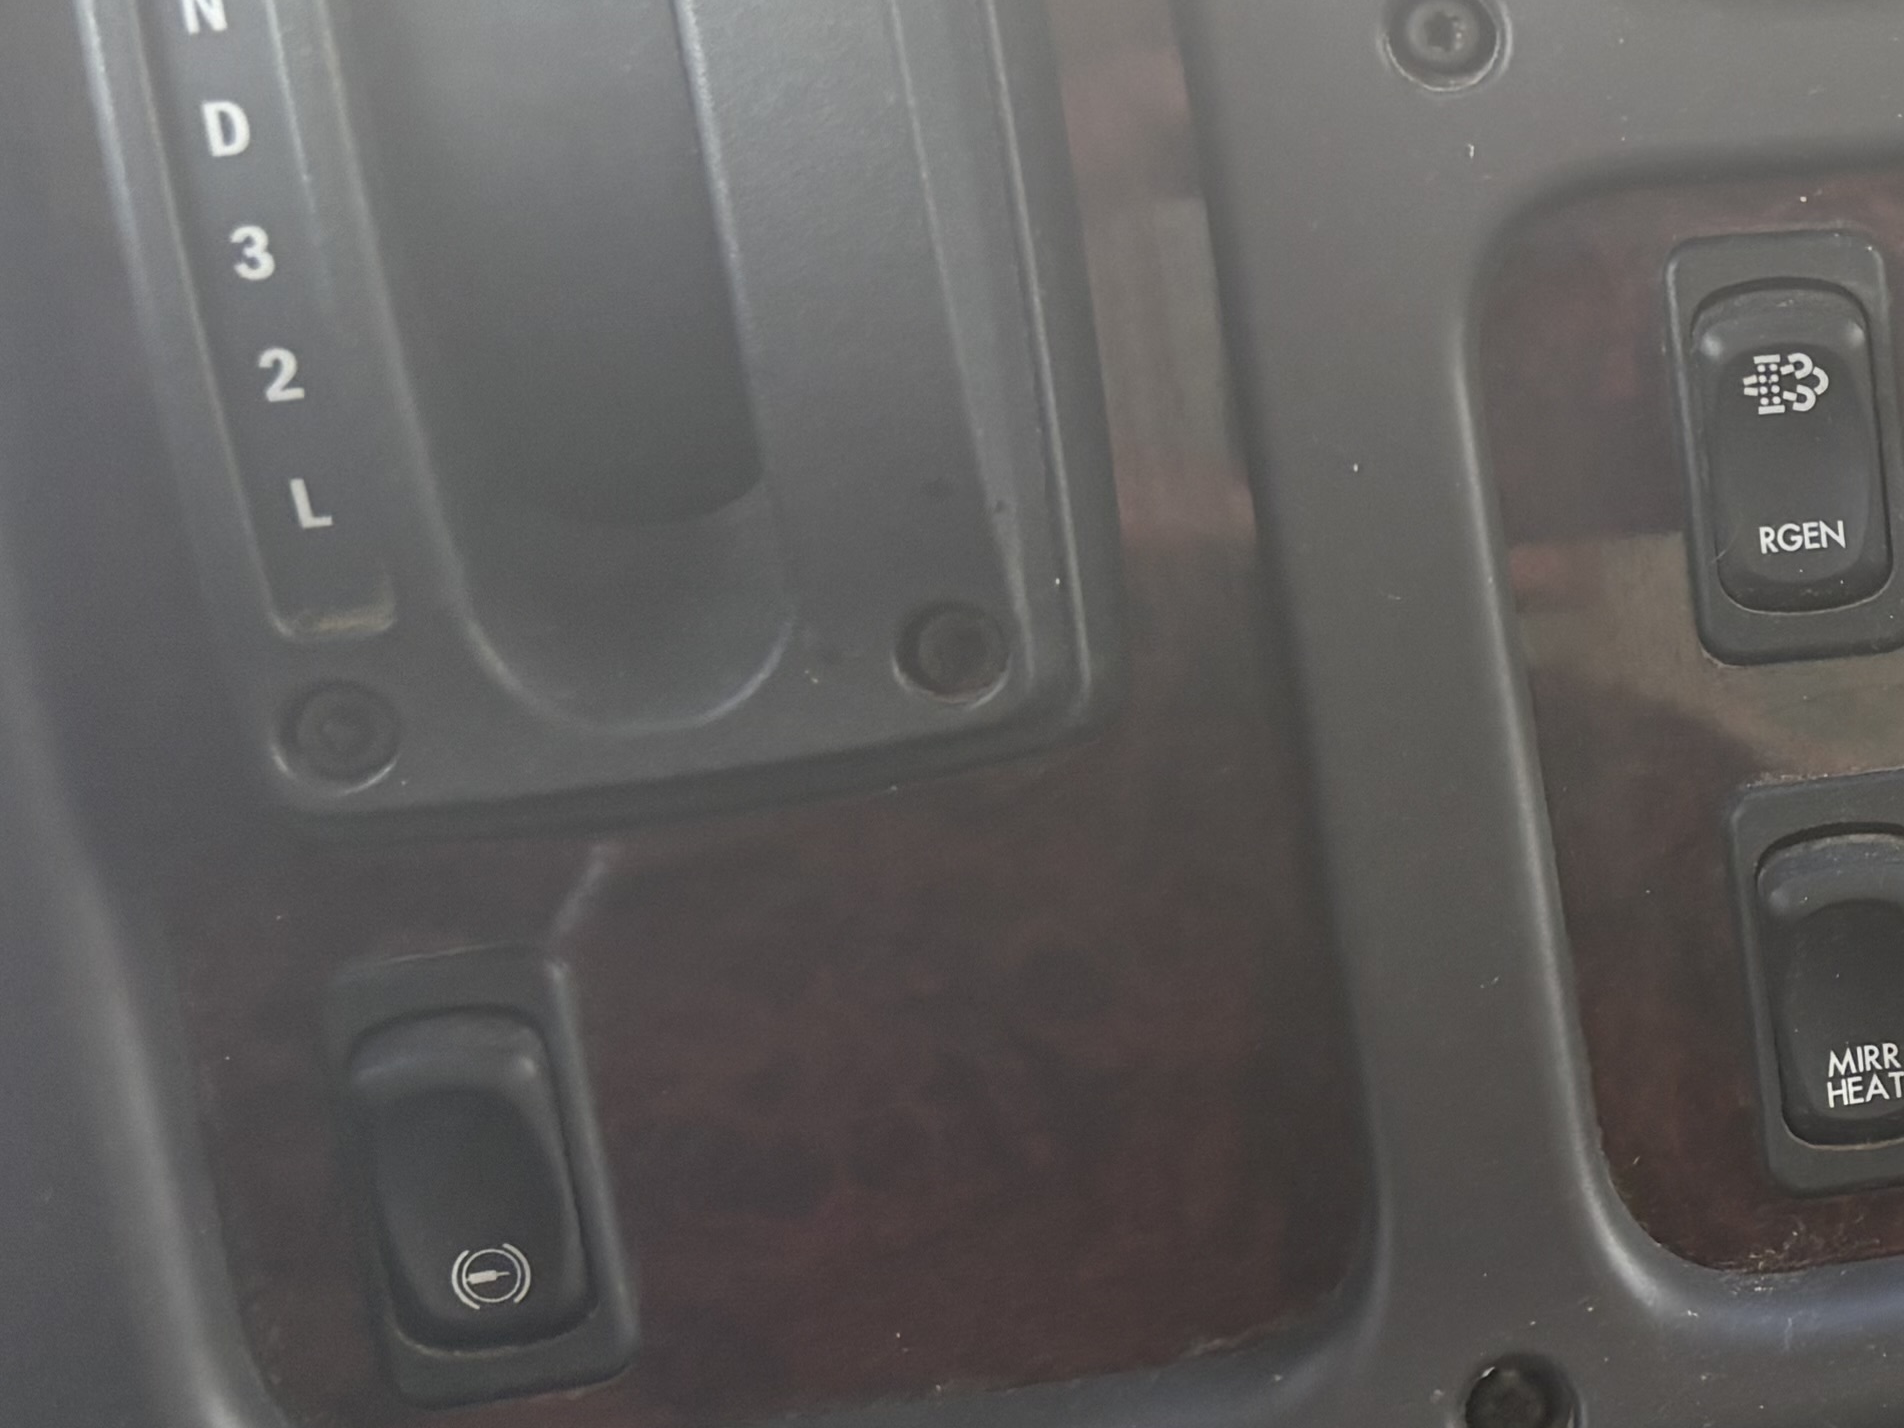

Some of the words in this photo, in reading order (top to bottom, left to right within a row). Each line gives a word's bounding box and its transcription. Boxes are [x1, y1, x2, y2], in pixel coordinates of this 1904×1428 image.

[202, 100, 251, 157] D
[229, 225, 275, 281] 3
[258, 348, 305, 402] 2
[289, 477, 333, 529] L
[1759, 520, 1846, 553] RGEN
[1828, 1042, 1901, 1078] MIRR
